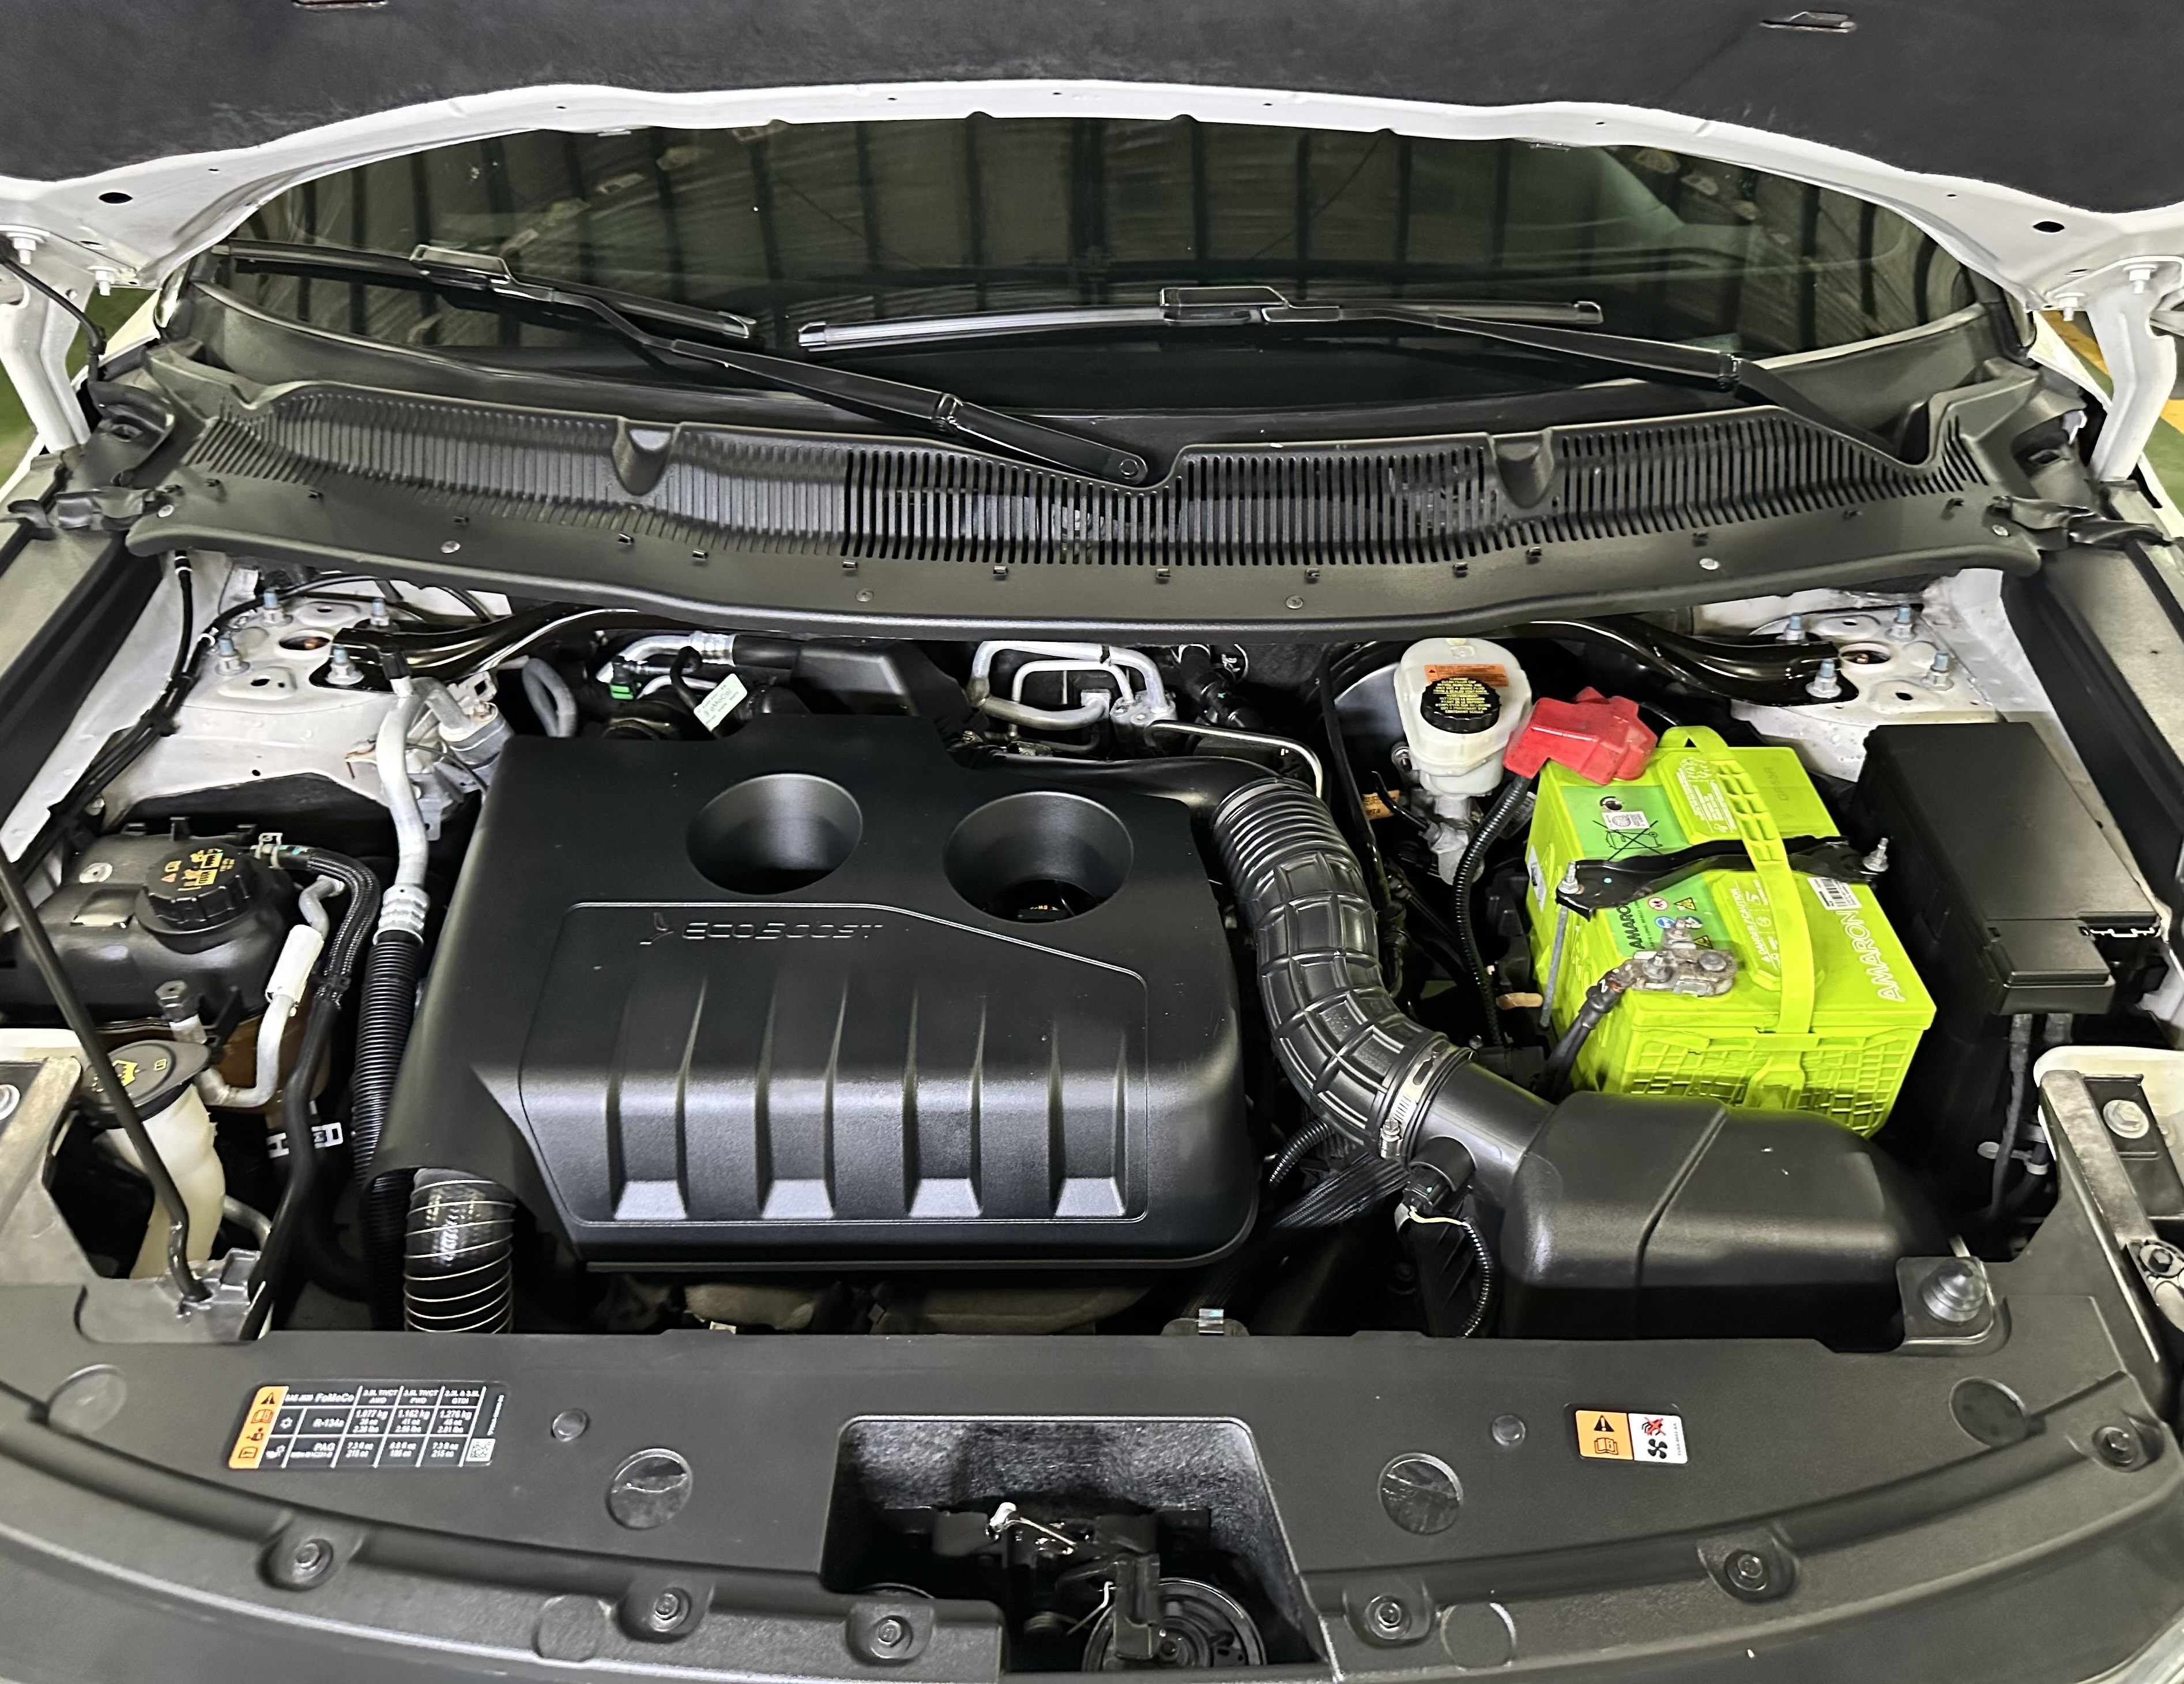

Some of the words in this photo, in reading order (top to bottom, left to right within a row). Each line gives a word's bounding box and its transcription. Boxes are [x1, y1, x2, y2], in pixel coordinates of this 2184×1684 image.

[681, 922, 883, 939] ECOBOOST
[1616, 903, 1645, 949] AMARO
[1835, 910, 1906, 1002] AMARON
[315, 1393, 355, 1403] FoMoCo
[356, 1409, 377, 1418] 1.077
[376, 1409, 388, 1420] kg
[419, 1409, 431, 1420] kg
[440, 1409, 461, 1419] 1.276
[461, 1409, 472, 1421] kg
[313, 1418, 345, 1428] R-134a
[314, 1442, 336, 1452] PAG
